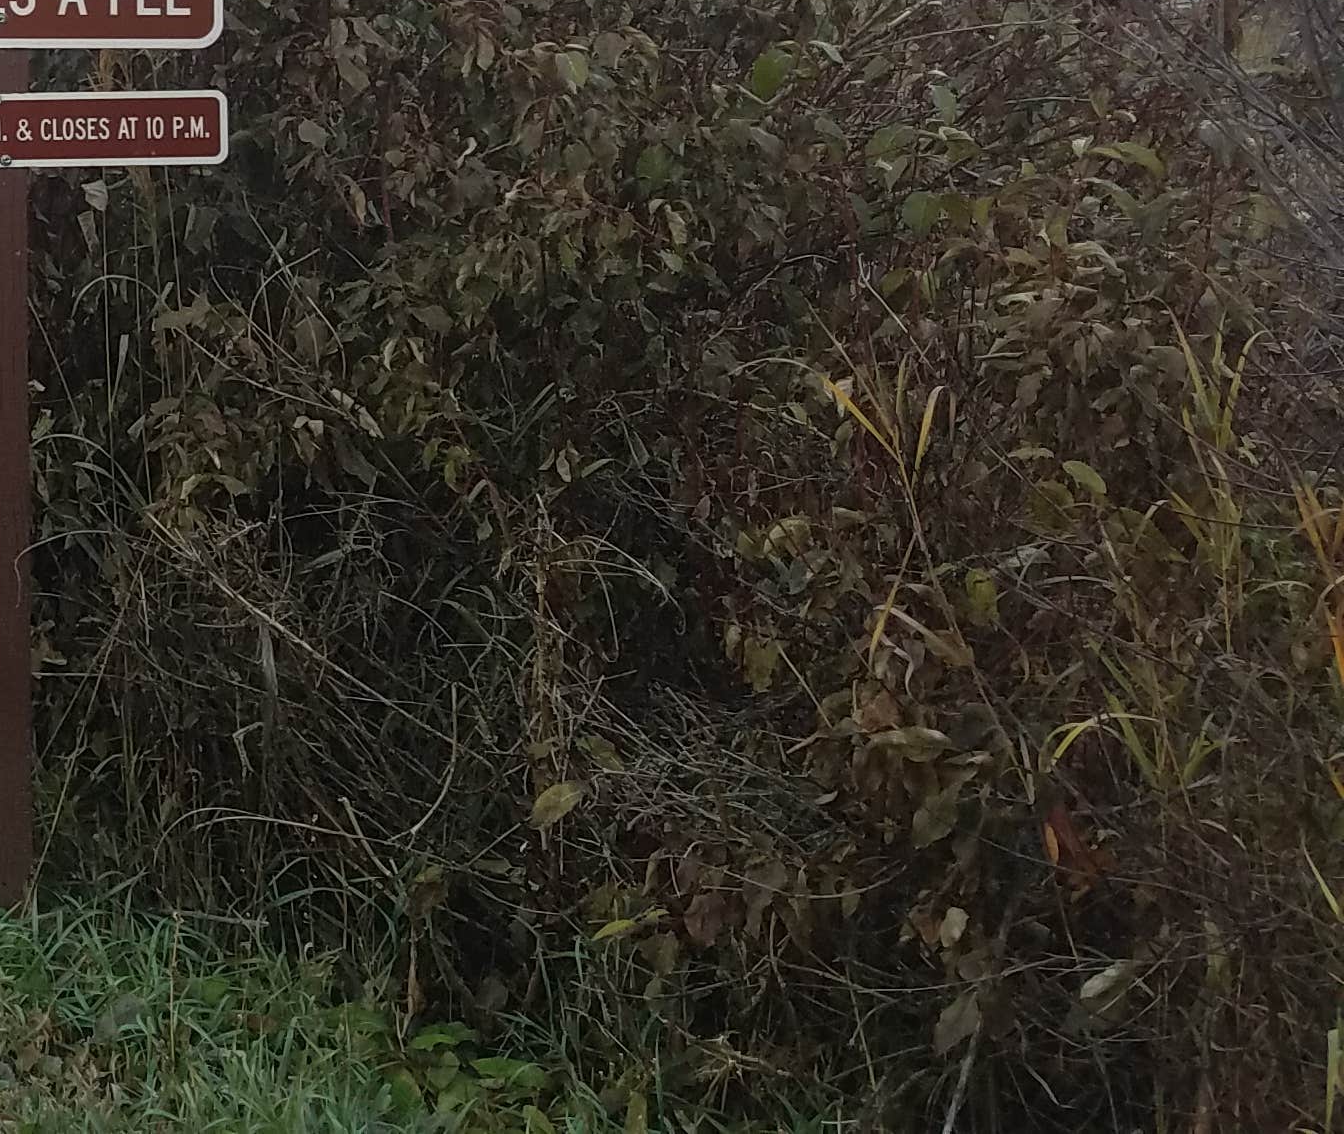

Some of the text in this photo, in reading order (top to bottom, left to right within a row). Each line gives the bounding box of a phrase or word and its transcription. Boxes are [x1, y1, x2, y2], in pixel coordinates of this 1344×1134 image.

[16, 118, 33, 141] &
[40, 117, 110, 141] CLOSES
[117, 116, 139, 140] AT
[146, 115, 164, 139] 10
[172, 115, 211, 139] P.M.
